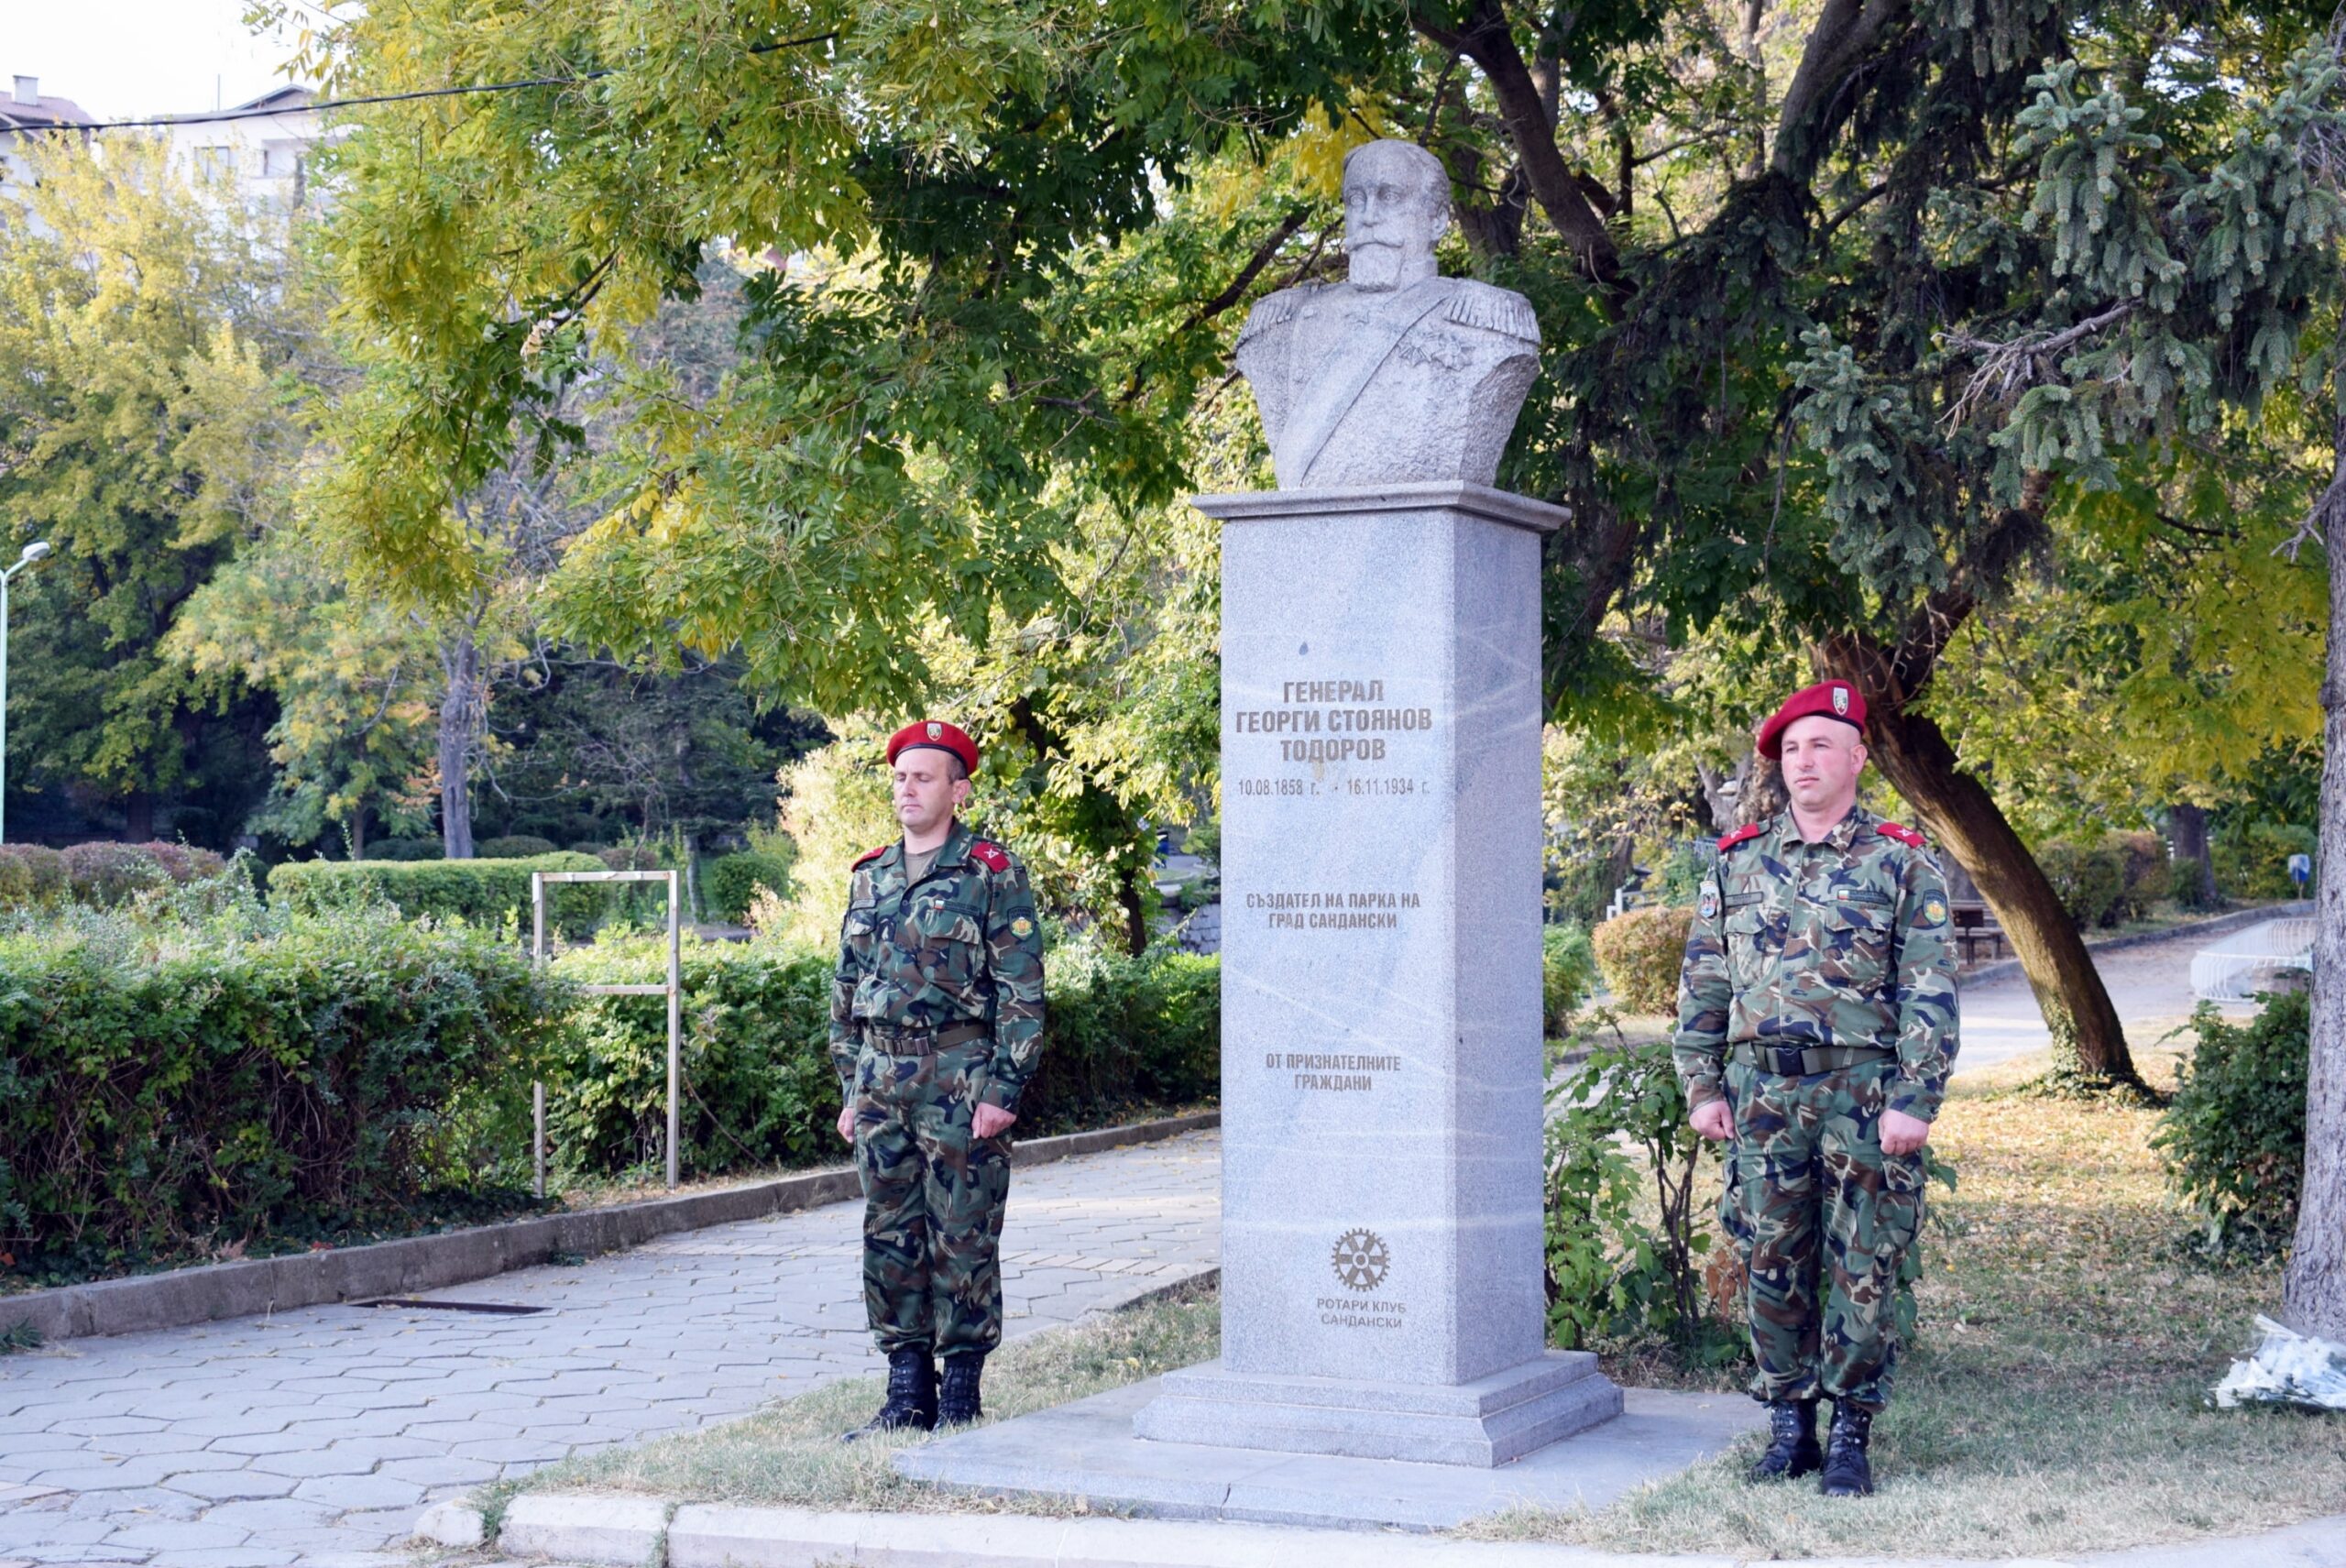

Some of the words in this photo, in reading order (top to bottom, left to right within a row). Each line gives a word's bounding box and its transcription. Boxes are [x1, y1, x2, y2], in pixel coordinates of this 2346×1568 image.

[1283, 680, 1384, 703] ГЕНЕРАЛ
[1235, 710, 1321, 733] ГЕОРГИ
[1328, 707, 1432, 733] СТОЯНОВ
[1280, 738, 1386, 763] ТОДОРОВ
[1238, 778, 1303, 795] 10.08.1858
[1348, 777, 1414, 795] 16.11.1934
[1246, 893, 1321, 909] СЪЗДАТЕЛ
[1325, 893, 1343, 908] НА
[1348, 893, 1397, 908] ПАРКА
[1401, 893, 1420, 908] НА
[1268, 913, 1304, 930] ГРАД
[1309, 913, 1398, 930] САНДАНСКИ
[1266, 1053, 1282, 1069] ОТ
[1286, 1054, 1401, 1071] ПРИЗНАТЕЛНИТЕ
[1294, 1074, 1372, 1092] ГРАЖДАНИ
[1317, 1298, 1368, 1310] РОТАРИ
[1373, 1301, 1407, 1312] КЛУБ
[1321, 1313, 1402, 1327] САНДАНСКИ
